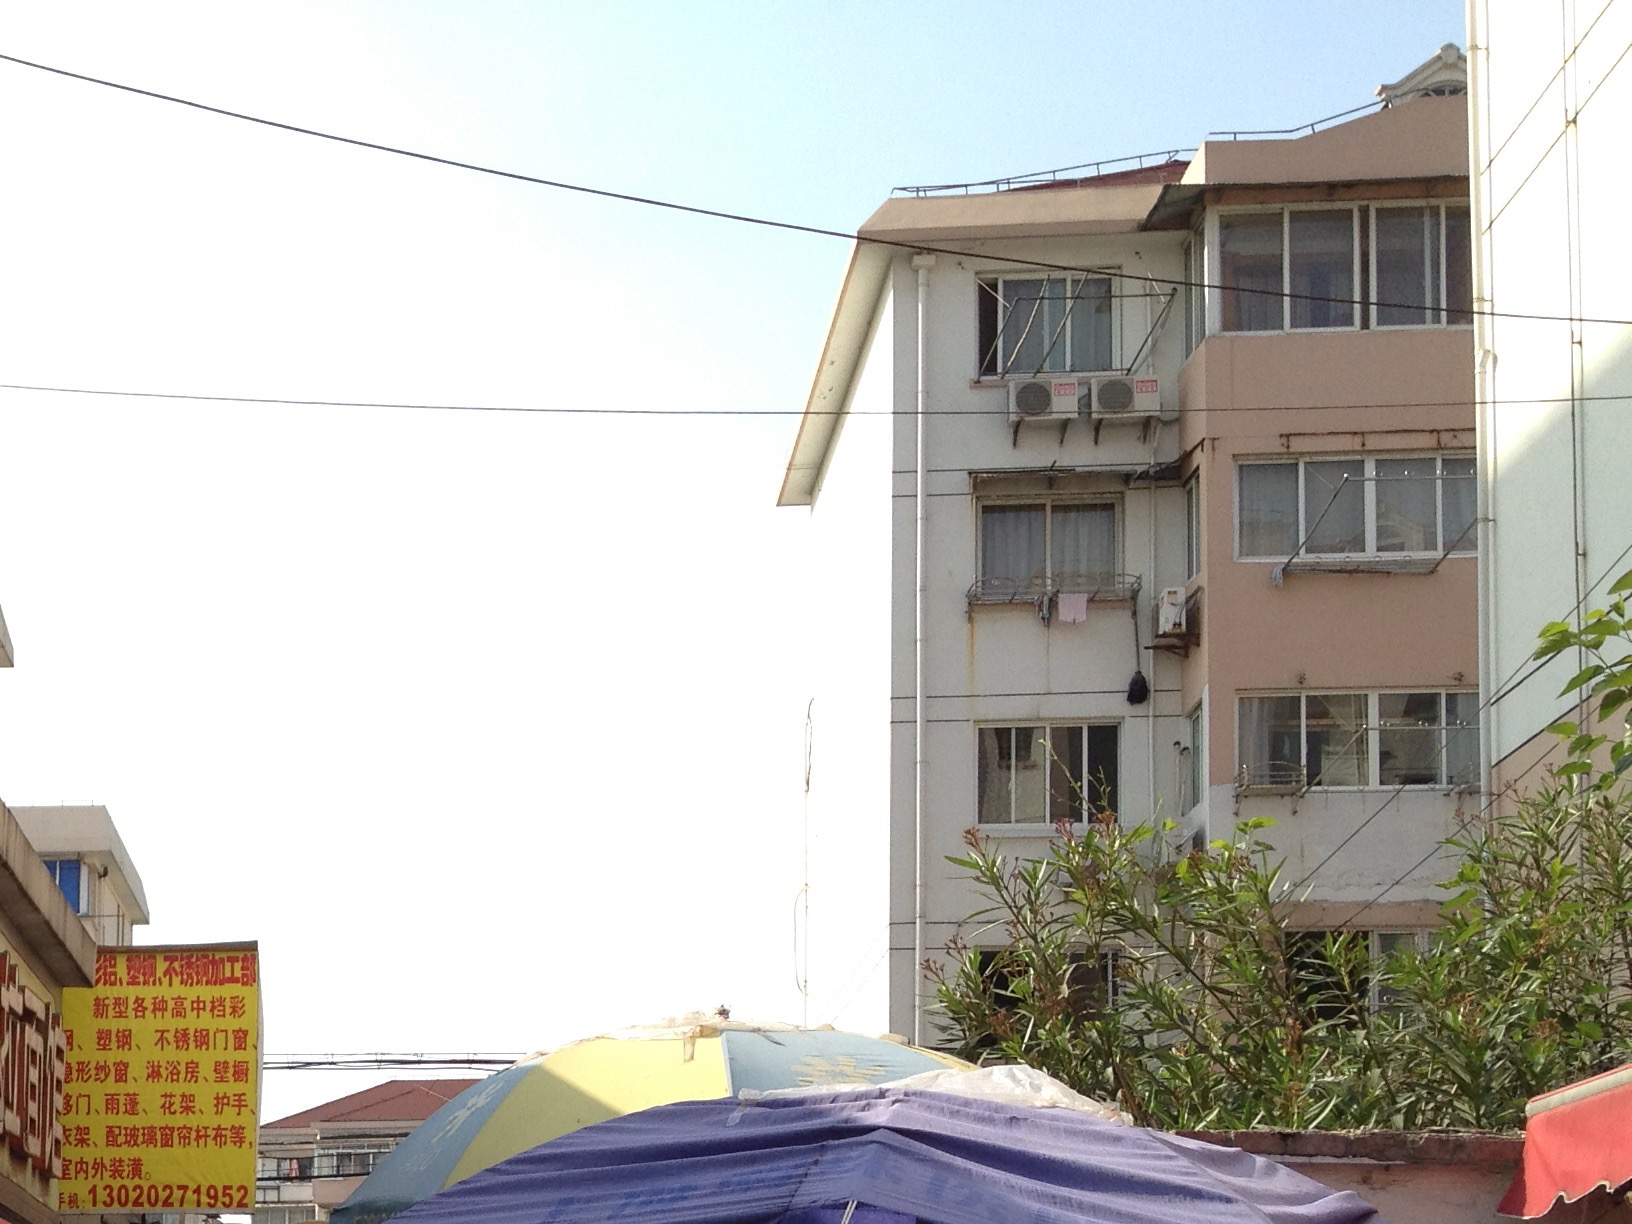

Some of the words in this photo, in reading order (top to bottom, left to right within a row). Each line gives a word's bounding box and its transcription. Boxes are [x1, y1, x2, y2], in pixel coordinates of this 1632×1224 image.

[93, 995, 245, 1019] 新型各种高中档彩
